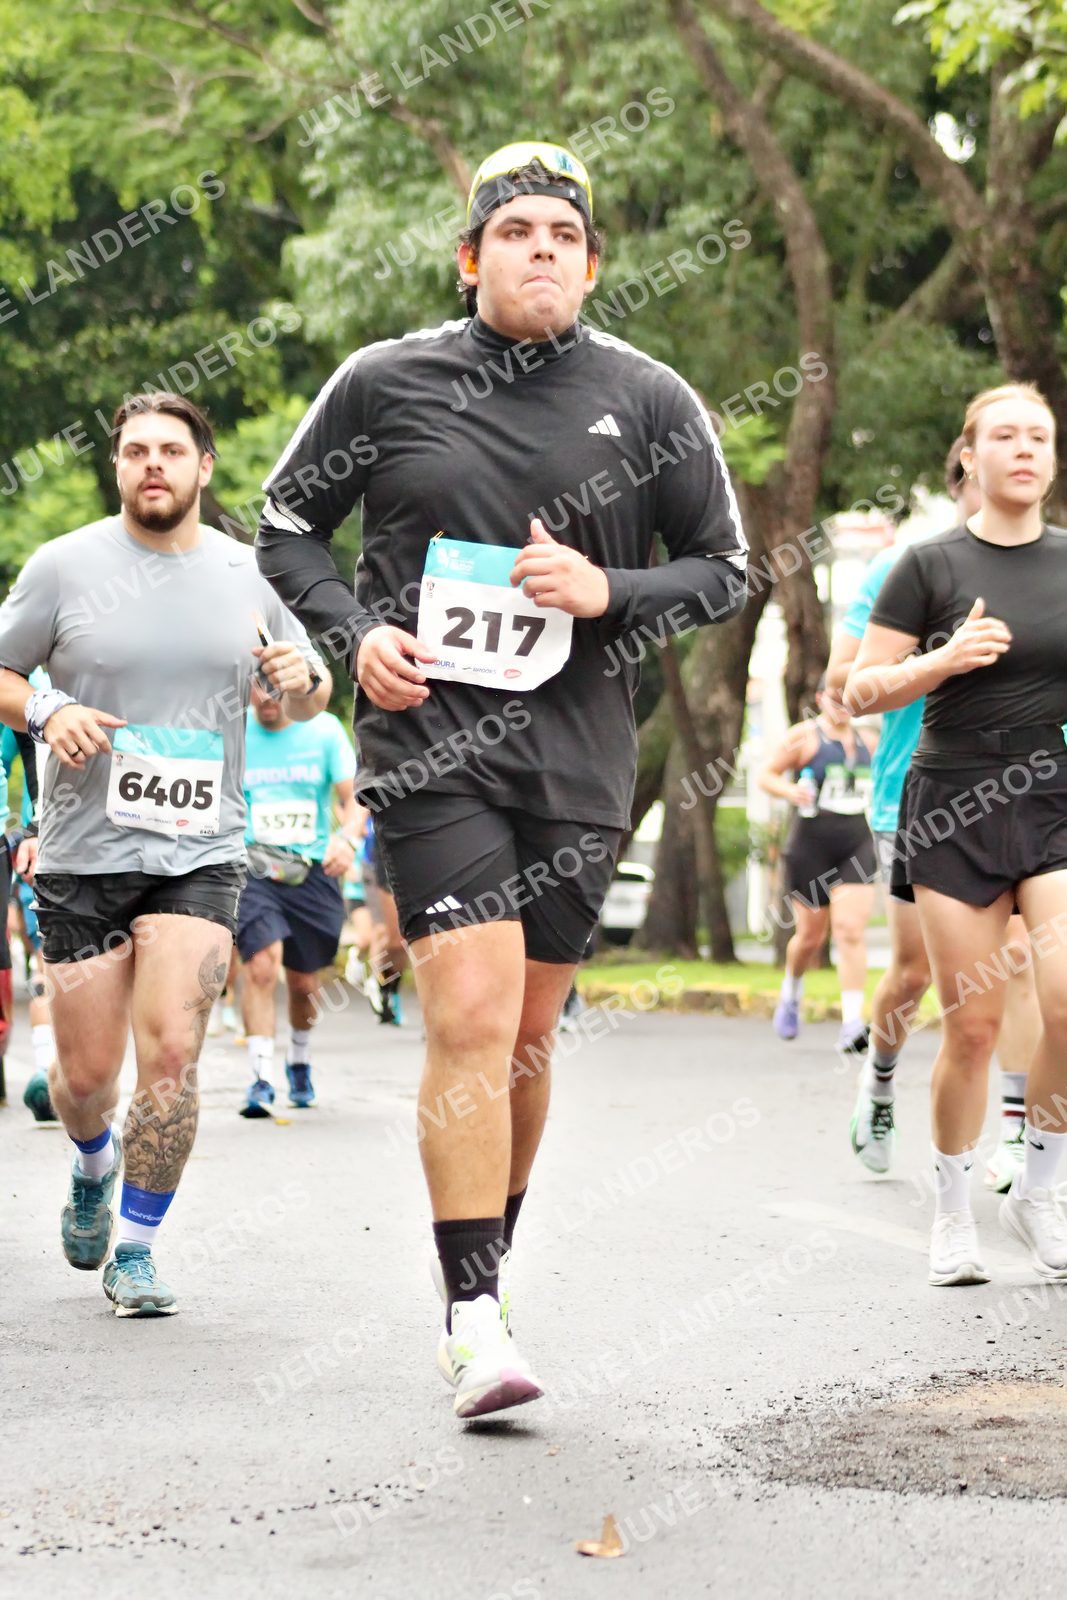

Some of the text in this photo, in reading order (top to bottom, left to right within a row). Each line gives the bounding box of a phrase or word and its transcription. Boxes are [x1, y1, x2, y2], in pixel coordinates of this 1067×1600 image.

[442, 606, 546, 657] 217
[244, 764, 322, 786] ERDURA
[118, 771, 214, 810] 6405
[260, 812, 312, 831] 3572
